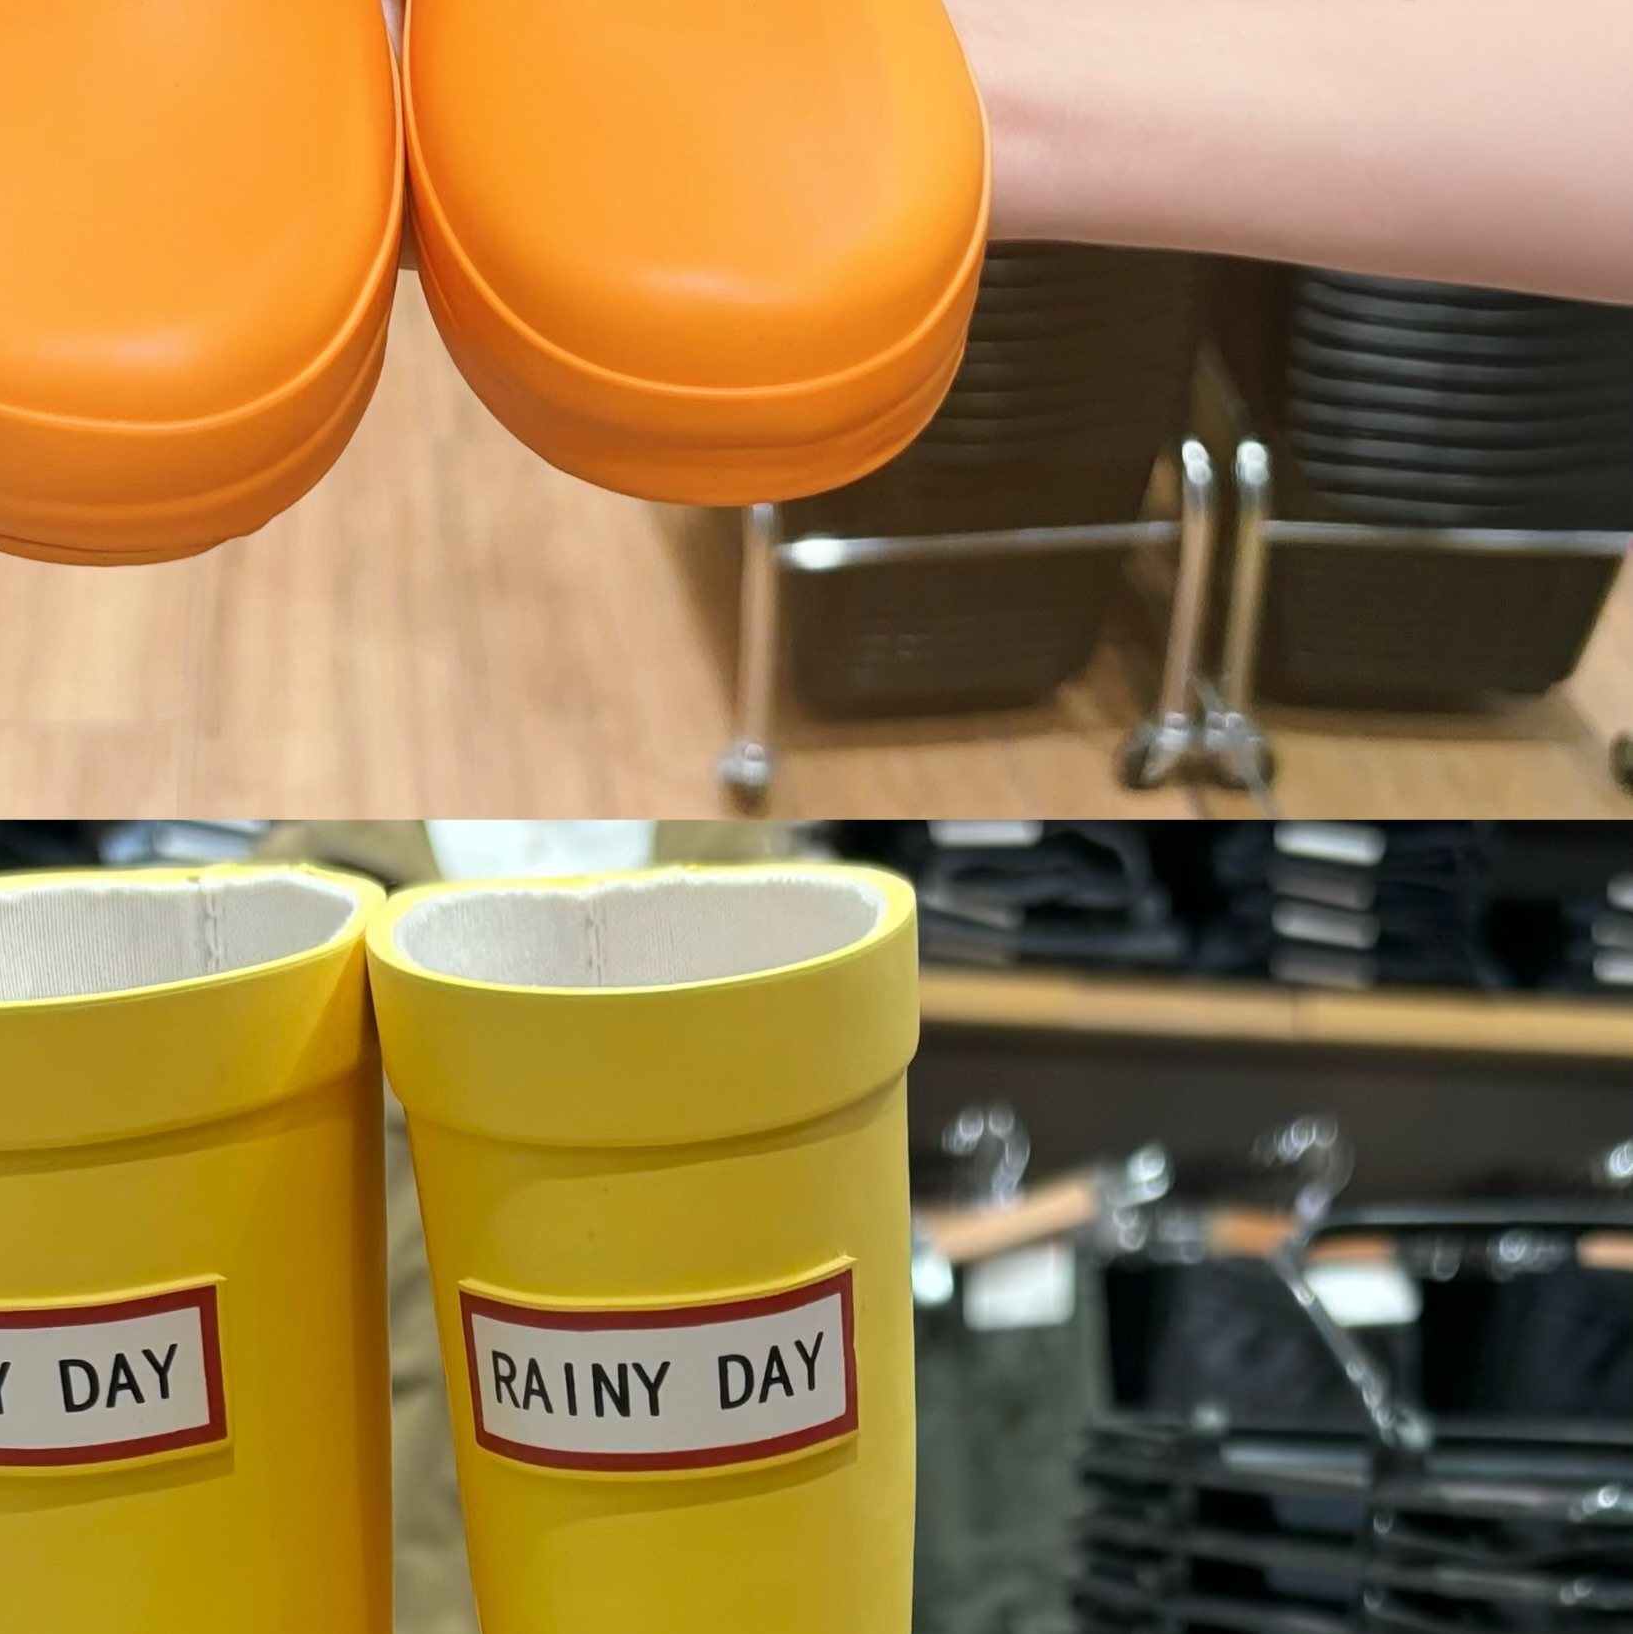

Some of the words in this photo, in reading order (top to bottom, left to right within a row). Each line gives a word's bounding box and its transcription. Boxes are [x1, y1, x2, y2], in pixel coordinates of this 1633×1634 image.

[57, 1342, 179, 1414] DAY
[490, 1348, 672, 1419] RAINY
[716, 1330, 825, 1412] DAY
